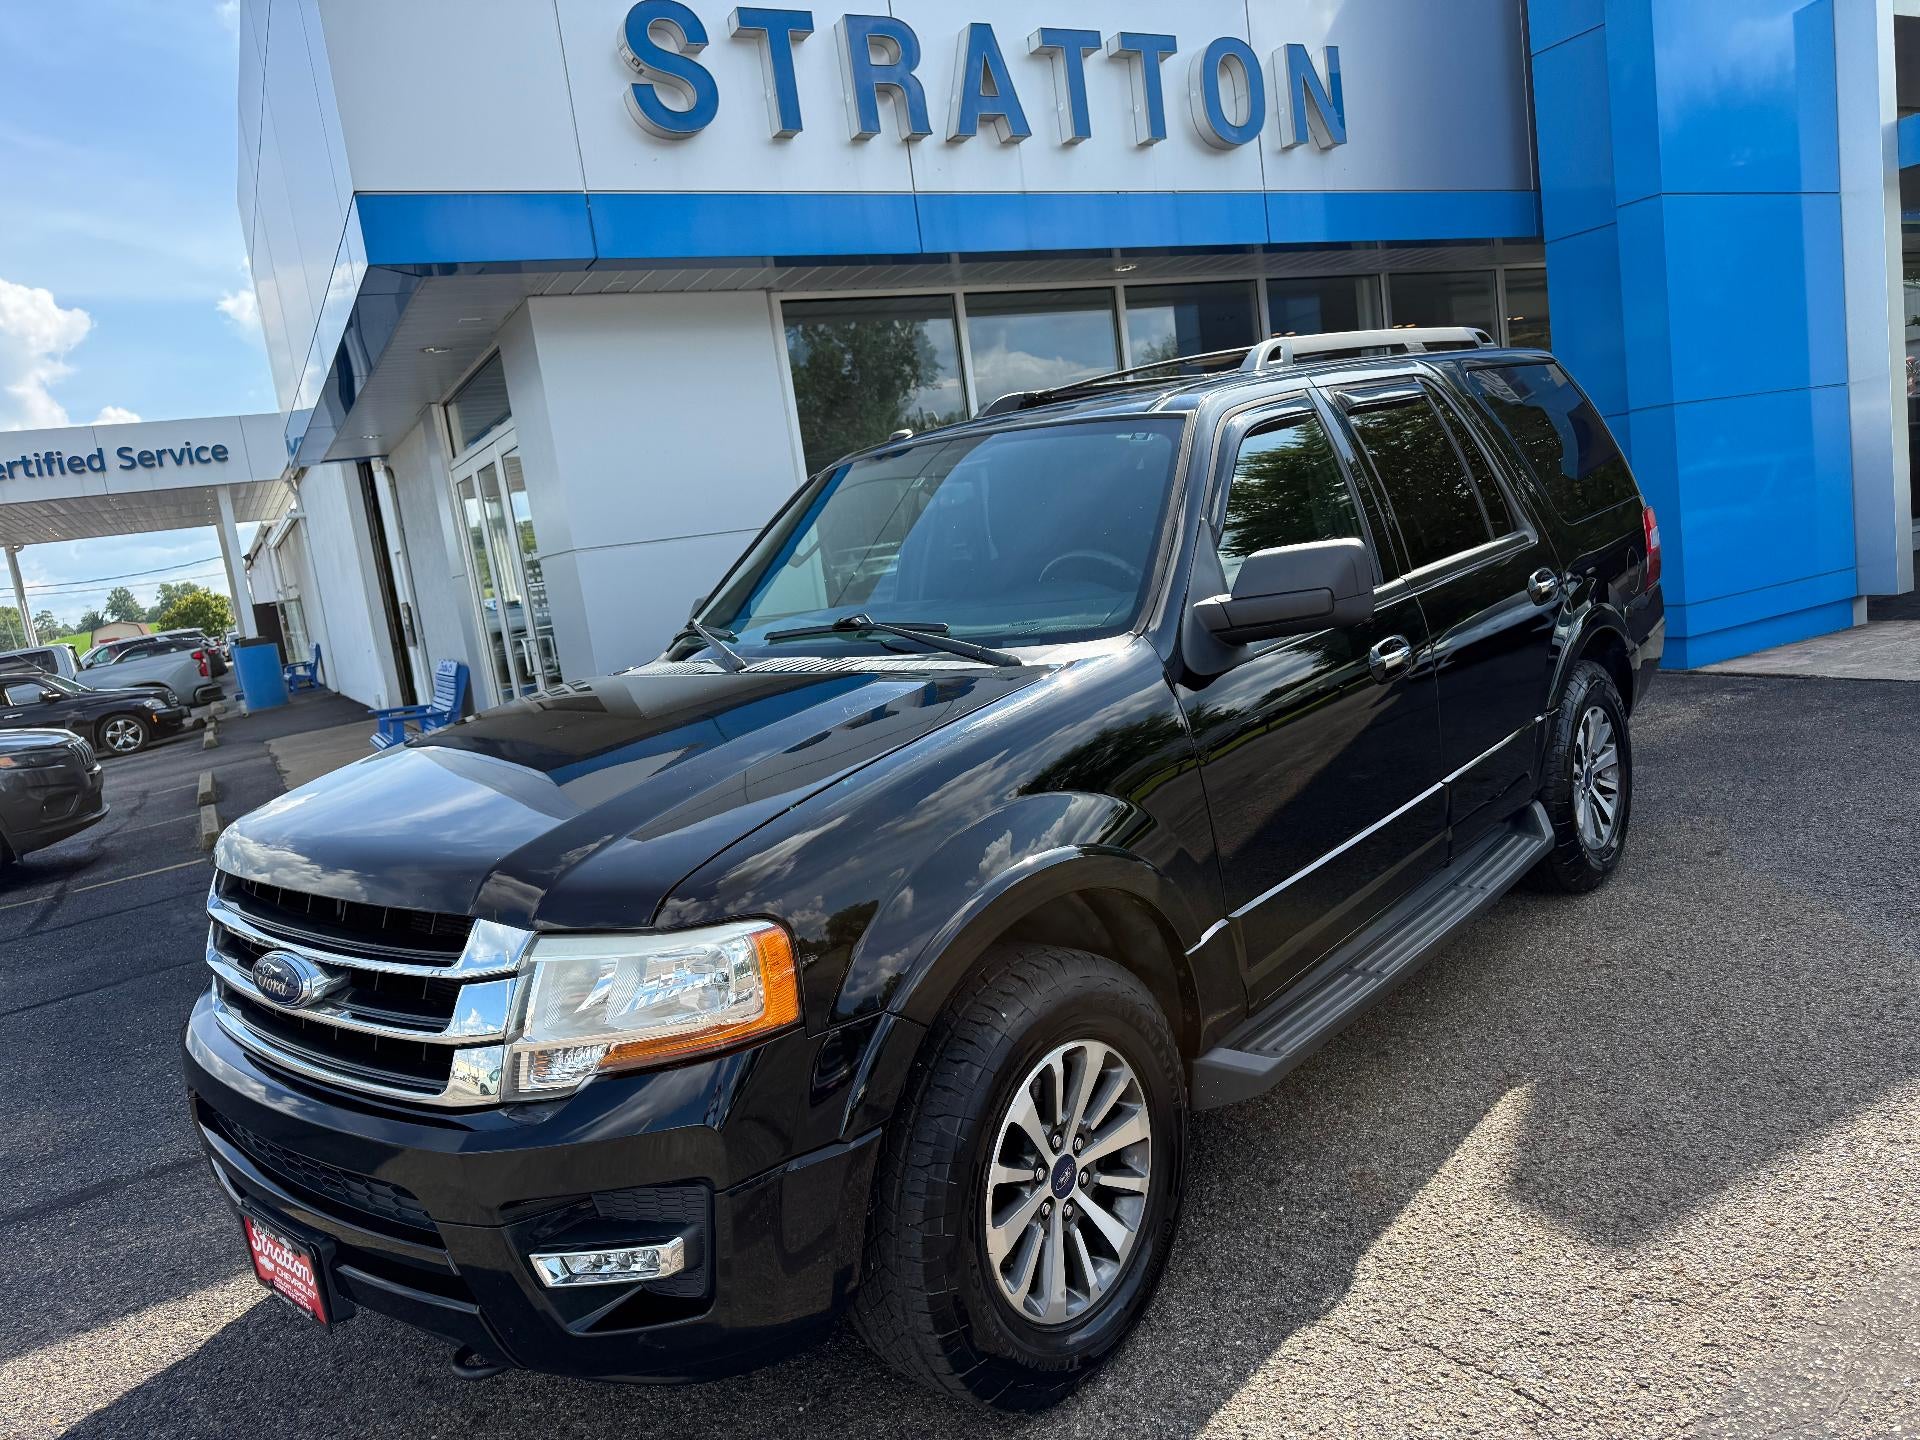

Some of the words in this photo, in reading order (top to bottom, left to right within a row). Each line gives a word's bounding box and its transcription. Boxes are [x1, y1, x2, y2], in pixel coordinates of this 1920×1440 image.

[618, 0, 1348, 149] STRATTON
[116, 441, 229, 470] Service
[251, 1227, 315, 1286] Stratton
